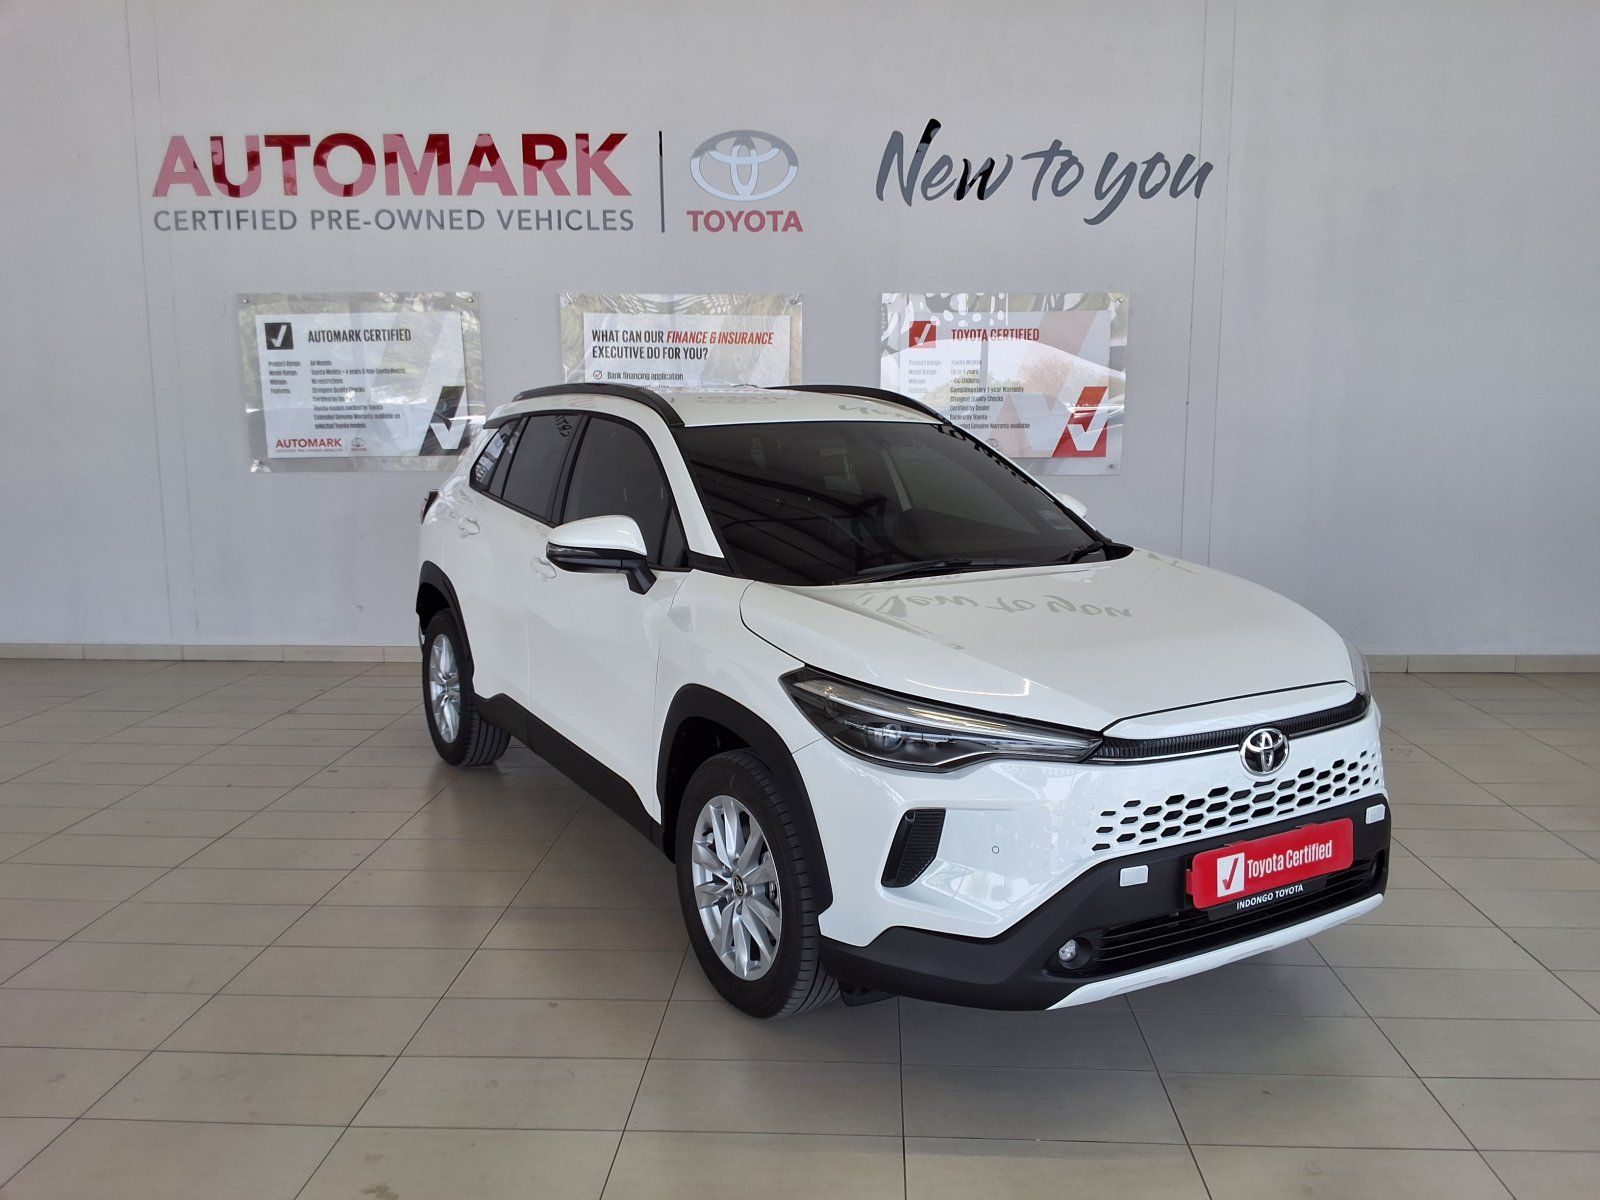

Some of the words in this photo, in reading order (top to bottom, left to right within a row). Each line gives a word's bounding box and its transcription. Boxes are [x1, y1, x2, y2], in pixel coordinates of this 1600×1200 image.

[152, 133, 632, 198] AUTOMARK
[875, 118, 1013, 207] New
[1021, 139, 1084, 201] to
[1083, 151, 1213, 225] you
[153, 209, 298, 232] CERTIFIED
[309, 209, 486, 232] PRE-OWNED
[496, 209, 634, 232] VEHICLES
[686, 210, 803, 233] TOYOTA
[308, 329, 362, 343] AUTOMARK
[364, 328, 411, 342] CERTIFIED
[592, 330, 620, 343] WHAT
[622, 331, 641, 343] CAN
[644, 331, 663, 343] OUR
[666, 331, 707, 344] FINANCE
[709, 332, 716, 344] &
[718, 332, 774, 345] INSURANCE
[951, 329, 987, 341] TOYOTA
[990, 328, 1040, 341] CERTIFIED
[592, 347, 645, 359] EXECUTIVE
[647, 347, 660, 359] DO
[662, 347, 681, 359] FOR
[683, 347, 708, 360] YOU?
[607, 371, 621, 380] Bank
[623, 371, 649, 381] financing
[651, 372, 684, 381] application
[276, 439, 341, 448] AUTOMARK
[1247, 855, 1284, 879] Toyota
[1285, 840, 1333, 867] Certified
[1236, 893, 1274, 910] INDONGO
[1275, 884, 1303, 899] TOYOTA
